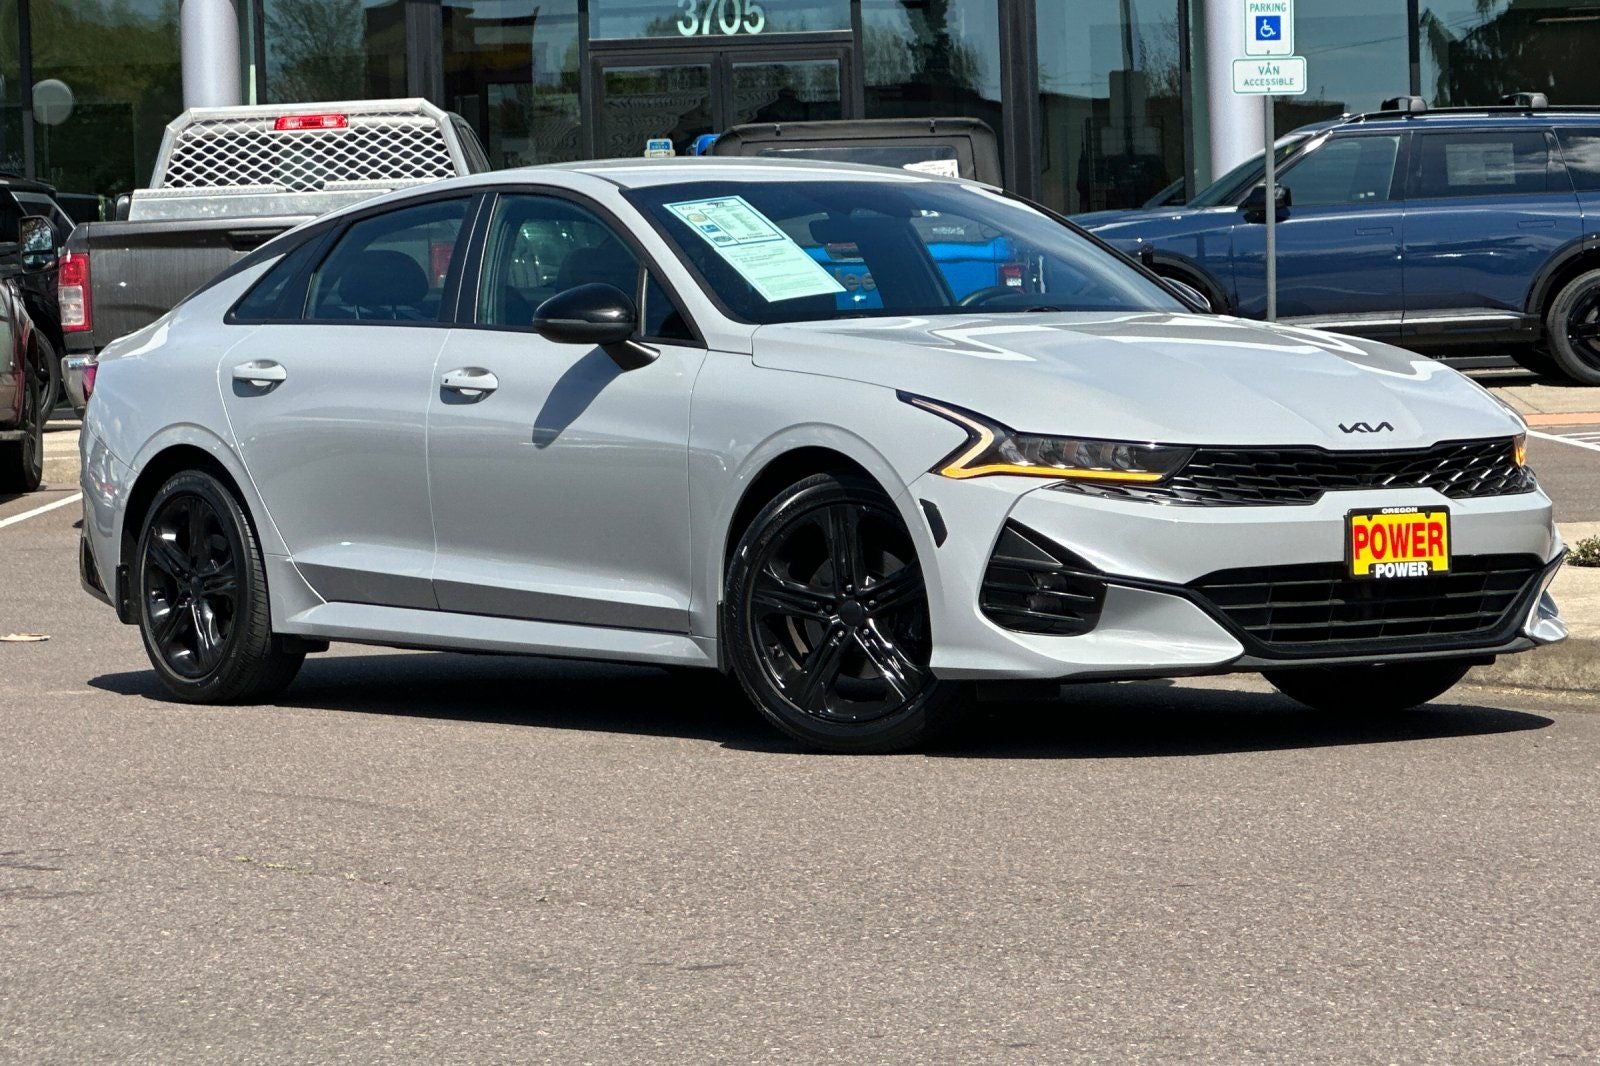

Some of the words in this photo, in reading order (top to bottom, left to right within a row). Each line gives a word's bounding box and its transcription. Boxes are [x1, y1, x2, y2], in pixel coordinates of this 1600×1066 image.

[1249, 3, 1287, 13] PARKING
[677, 0, 765, 36] 3705
[1258, 66, 1280, 75] VAN
[1244, 78, 1295, 86] ACCESSIBLE
[835, 267, 877, 291] Jee
[1338, 421, 1395, 433] KIA
[1381, 506, 1418, 514] OREGON
[1353, 522, 1445, 560] POWER
[1375, 562, 1428, 578] POWER
